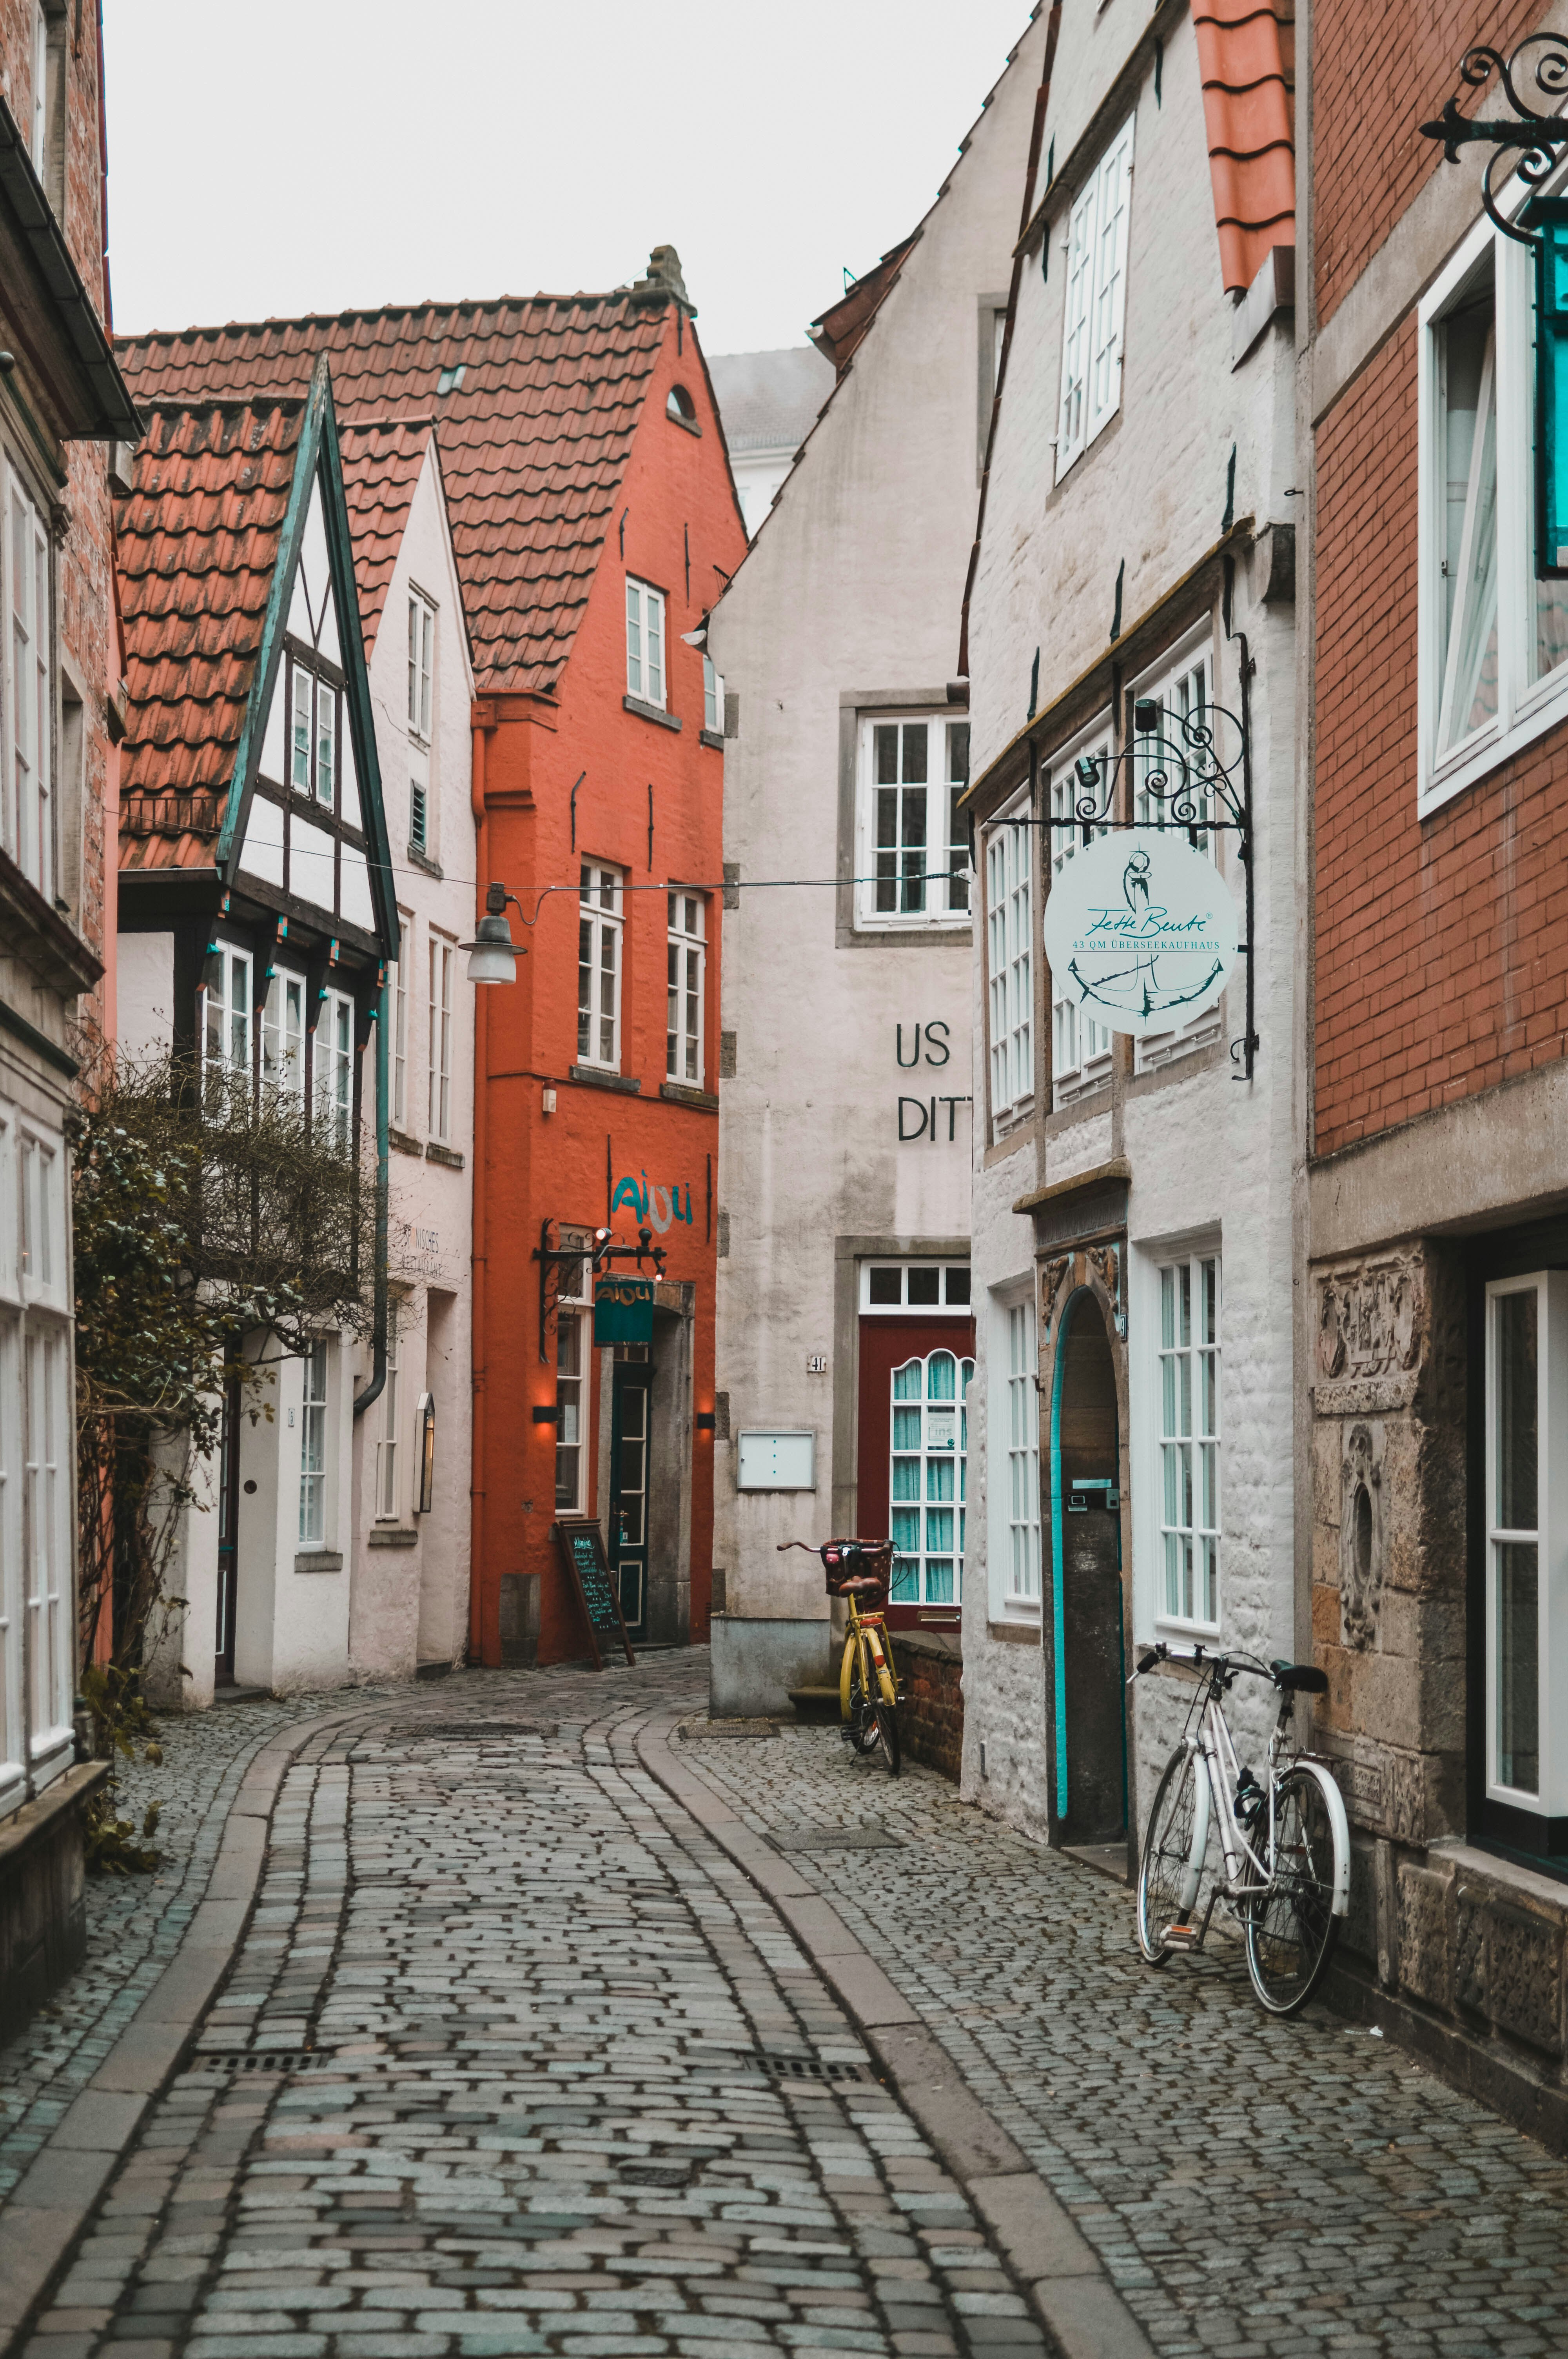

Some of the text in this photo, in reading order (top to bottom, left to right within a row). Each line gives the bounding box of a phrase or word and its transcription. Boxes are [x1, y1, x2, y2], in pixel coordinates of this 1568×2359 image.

[1085, 909, 1137, 936] Fette
[1120, 907, 1206, 939] Beute
[1089, 941, 1106, 950] QM
[1111, 940, 1220, 949] ÜBERSEEKAUFHAUS
[897, 1021, 950, 1067] US
[898, 1096, 973, 1141] DIT
[403, 1227, 439, 1253] SPNISCHES
[812, 1358, 822, 1370] 41
